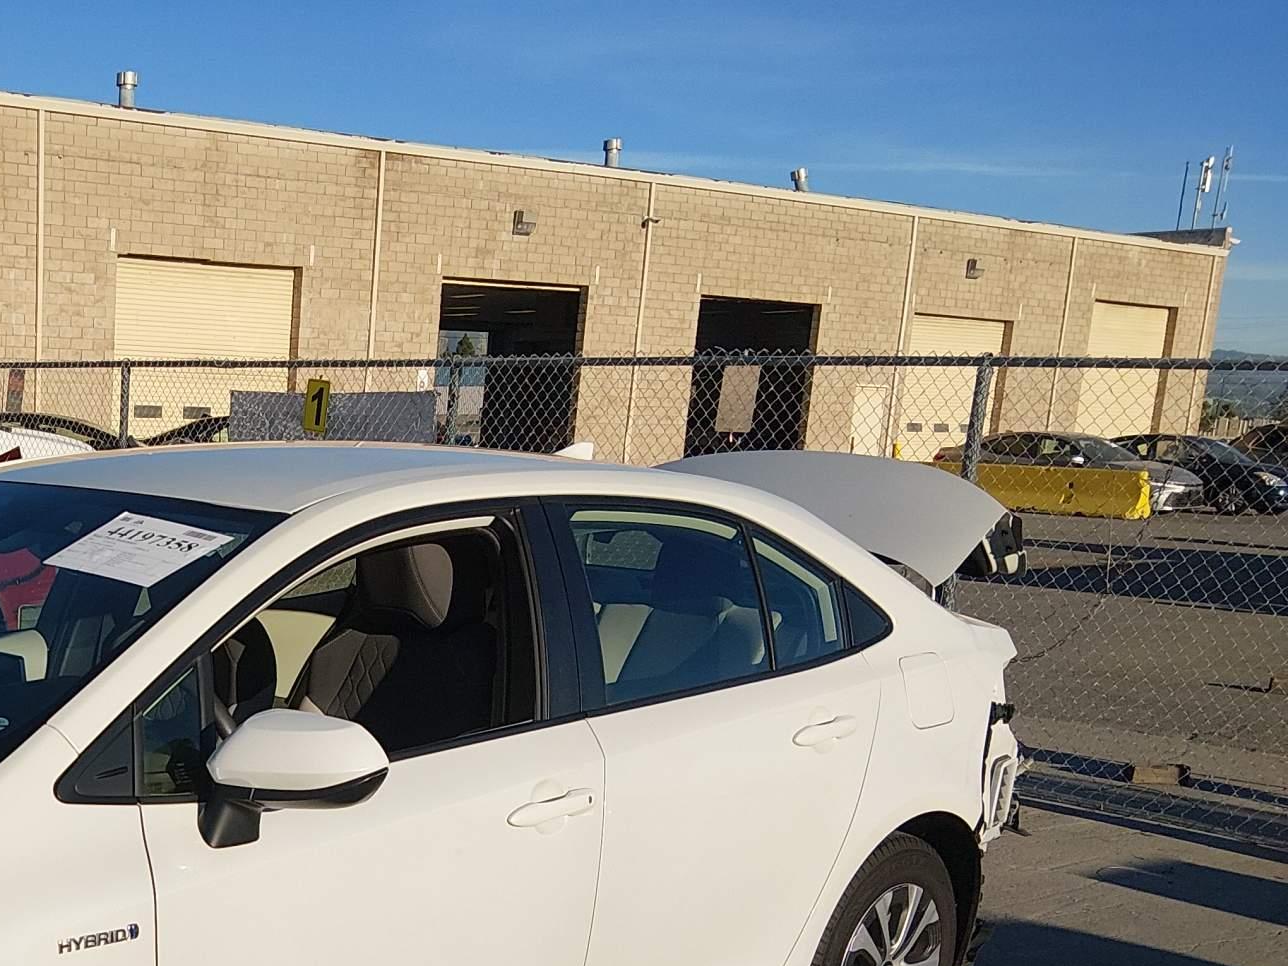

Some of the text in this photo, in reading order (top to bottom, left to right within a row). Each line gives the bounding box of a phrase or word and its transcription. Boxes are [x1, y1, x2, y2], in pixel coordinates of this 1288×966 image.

[311, 386, 324, 426] 1
[107, 526, 200, 553] 44197358
[57, 928, 128, 954] HYBRID
